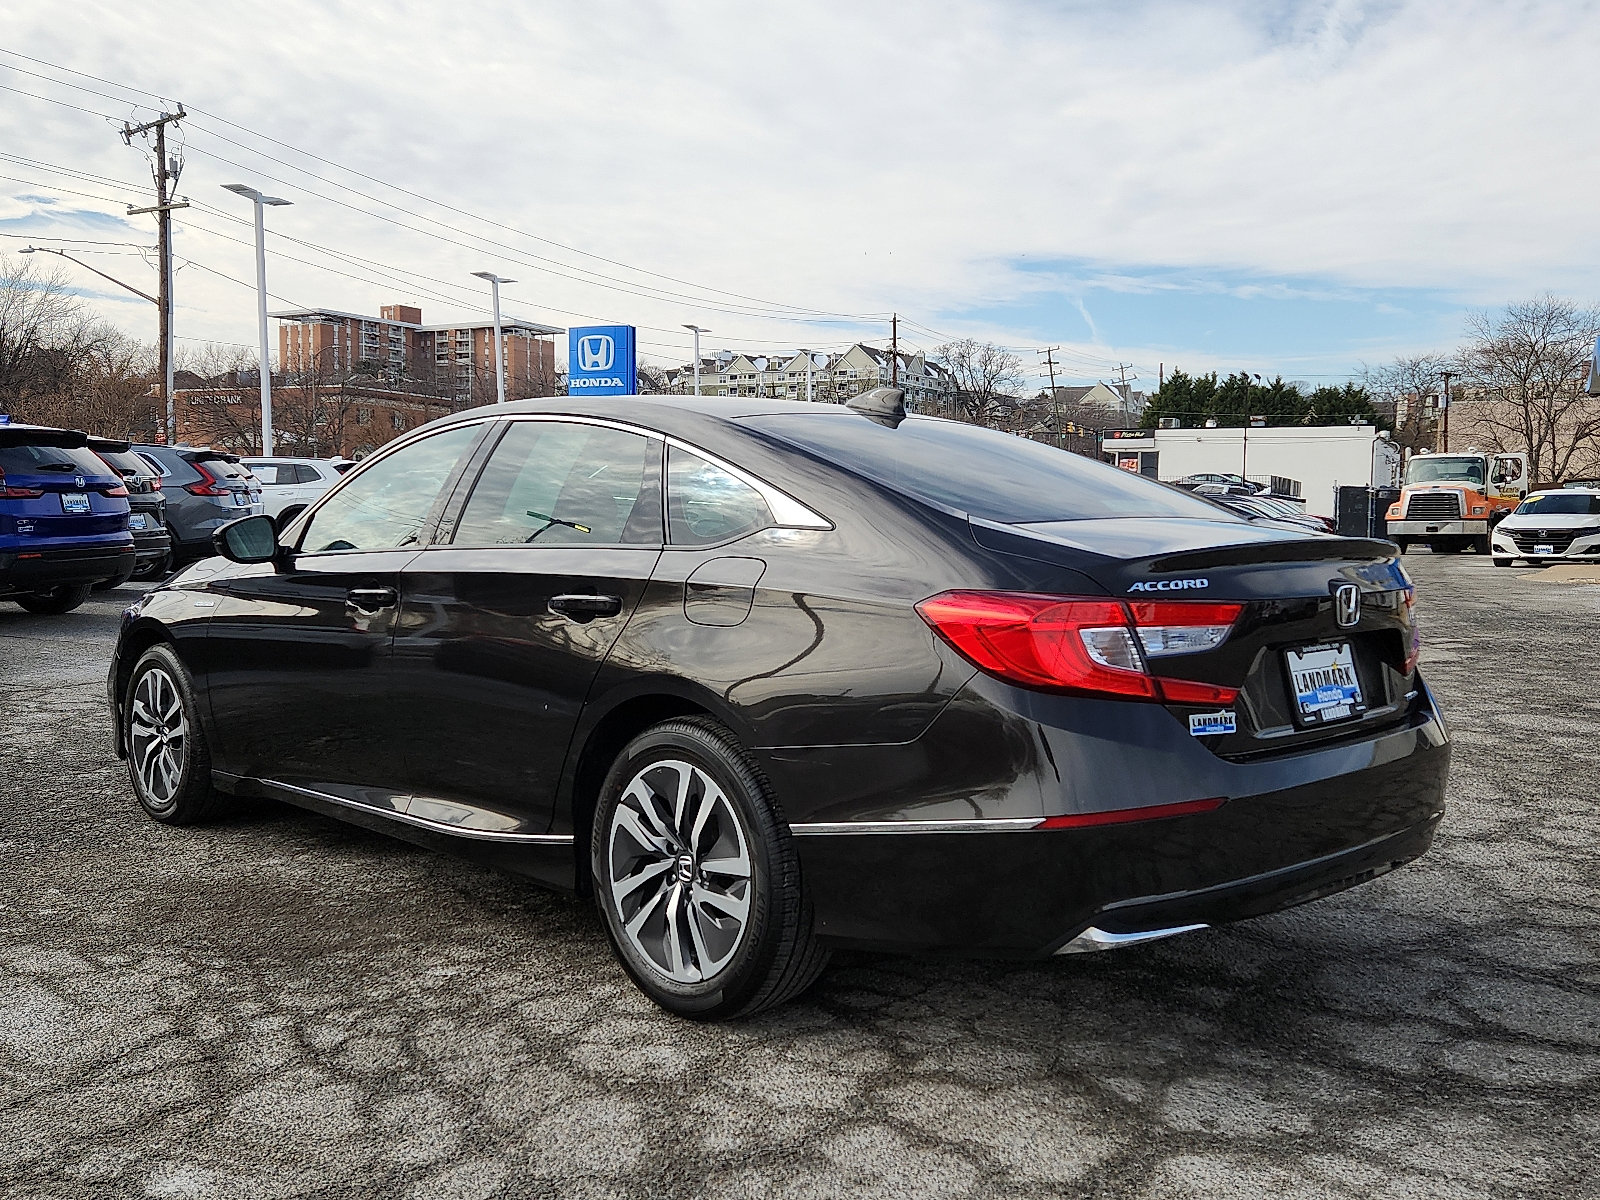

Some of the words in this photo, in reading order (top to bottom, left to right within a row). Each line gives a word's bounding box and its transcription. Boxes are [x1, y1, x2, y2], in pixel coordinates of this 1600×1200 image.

[570, 377, 624, 388] HONDA
[1127, 578, 1208, 592] ACCORD
[1295, 666, 1354, 693] LANDMARK
[1317, 688, 1343, 702] Honda
[1192, 716, 1233, 727] LANDMARK
